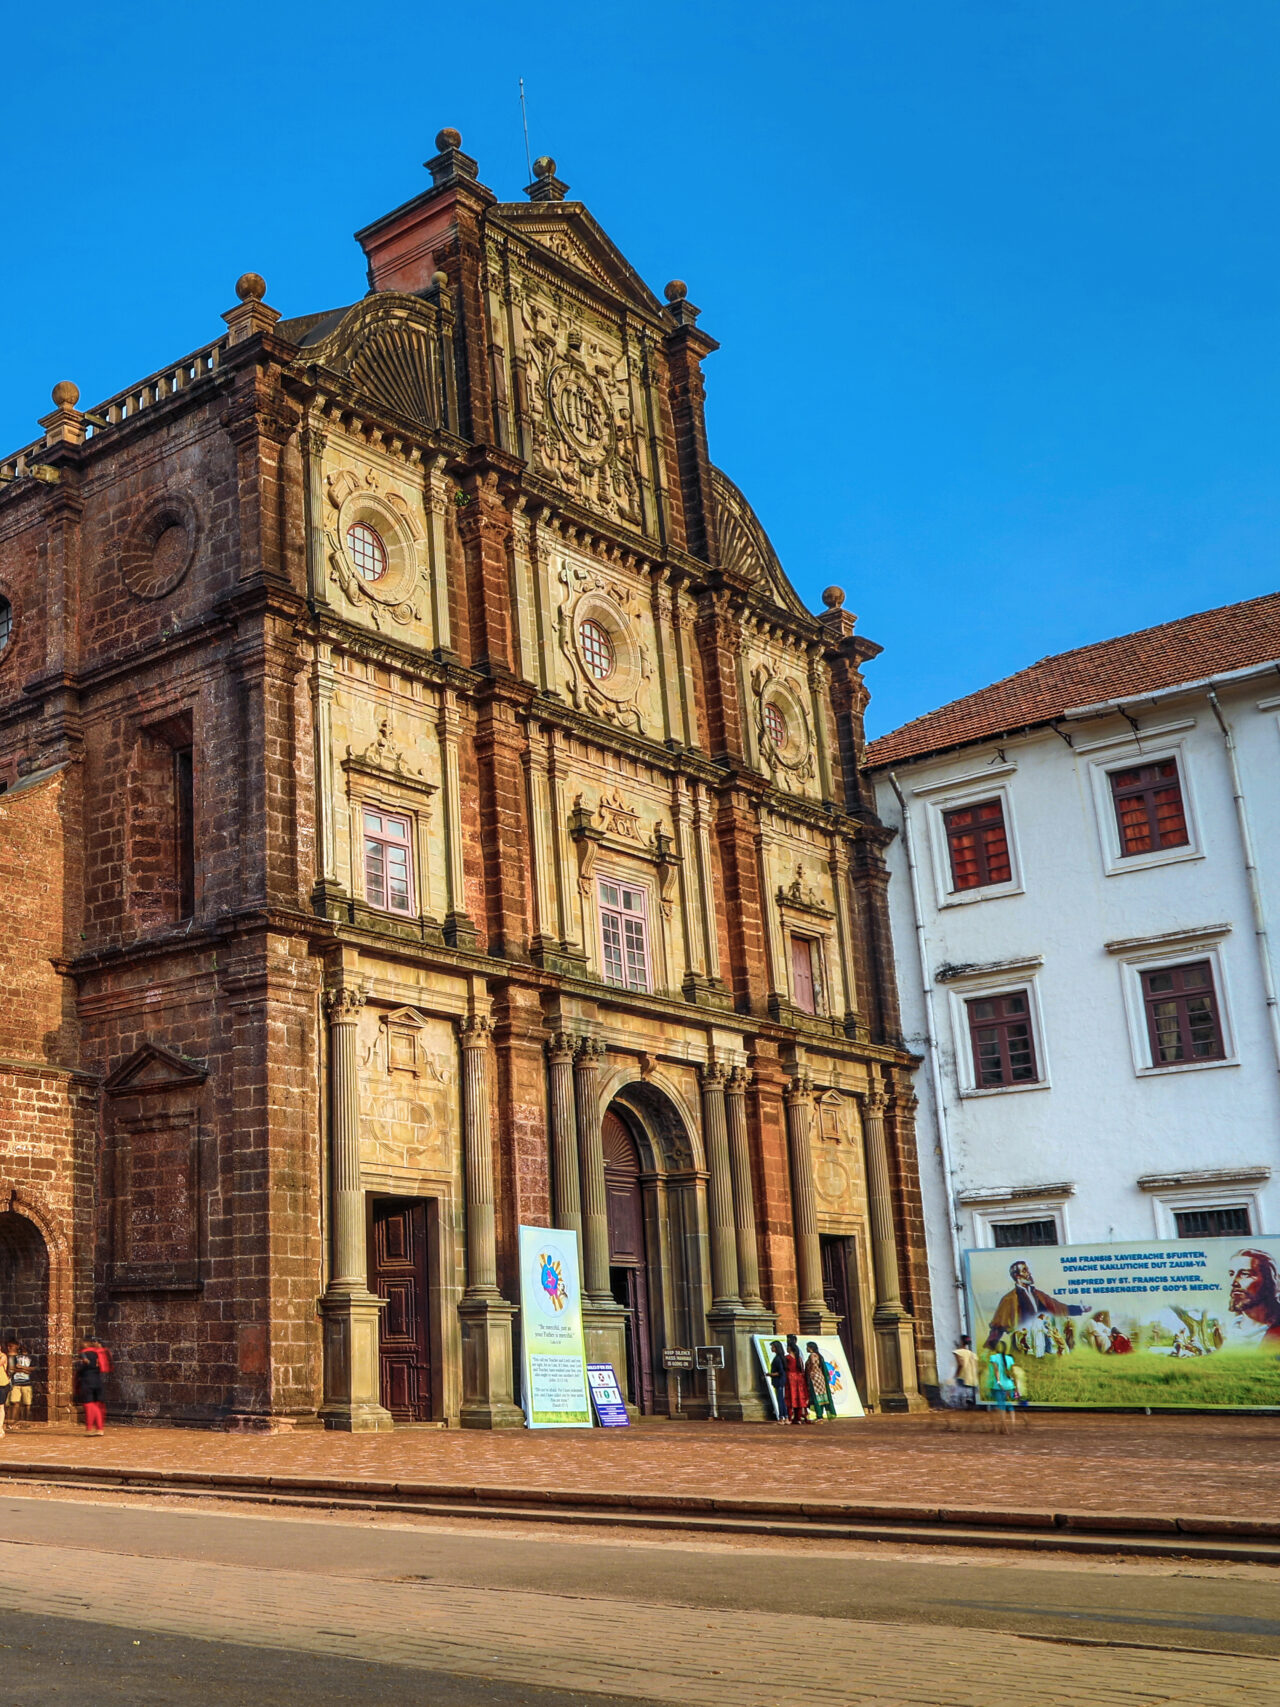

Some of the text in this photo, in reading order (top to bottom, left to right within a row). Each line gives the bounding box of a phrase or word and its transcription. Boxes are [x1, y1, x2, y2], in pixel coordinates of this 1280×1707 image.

[1114, 1253, 1164, 1261] XAVIERACHE
[1063, 1264, 1098, 1272] DEVACHE
[1151, 1261, 1167, 1269] DUT
[1169, 1260, 1206, 1268] ZAUM-YA
[1068, 1274, 1204, 1286] INSPIRED BY ST. FRANCIS XAVIER,
[1068, 1287, 1079, 1295] US
[1093, 1285, 1148, 1294] MESSENGERS
[1149, 1284, 1161, 1292] OF
[1162, 1284, 1188, 1292] GOD'S
[1189, 1283, 1223, 1291] MERCY.
